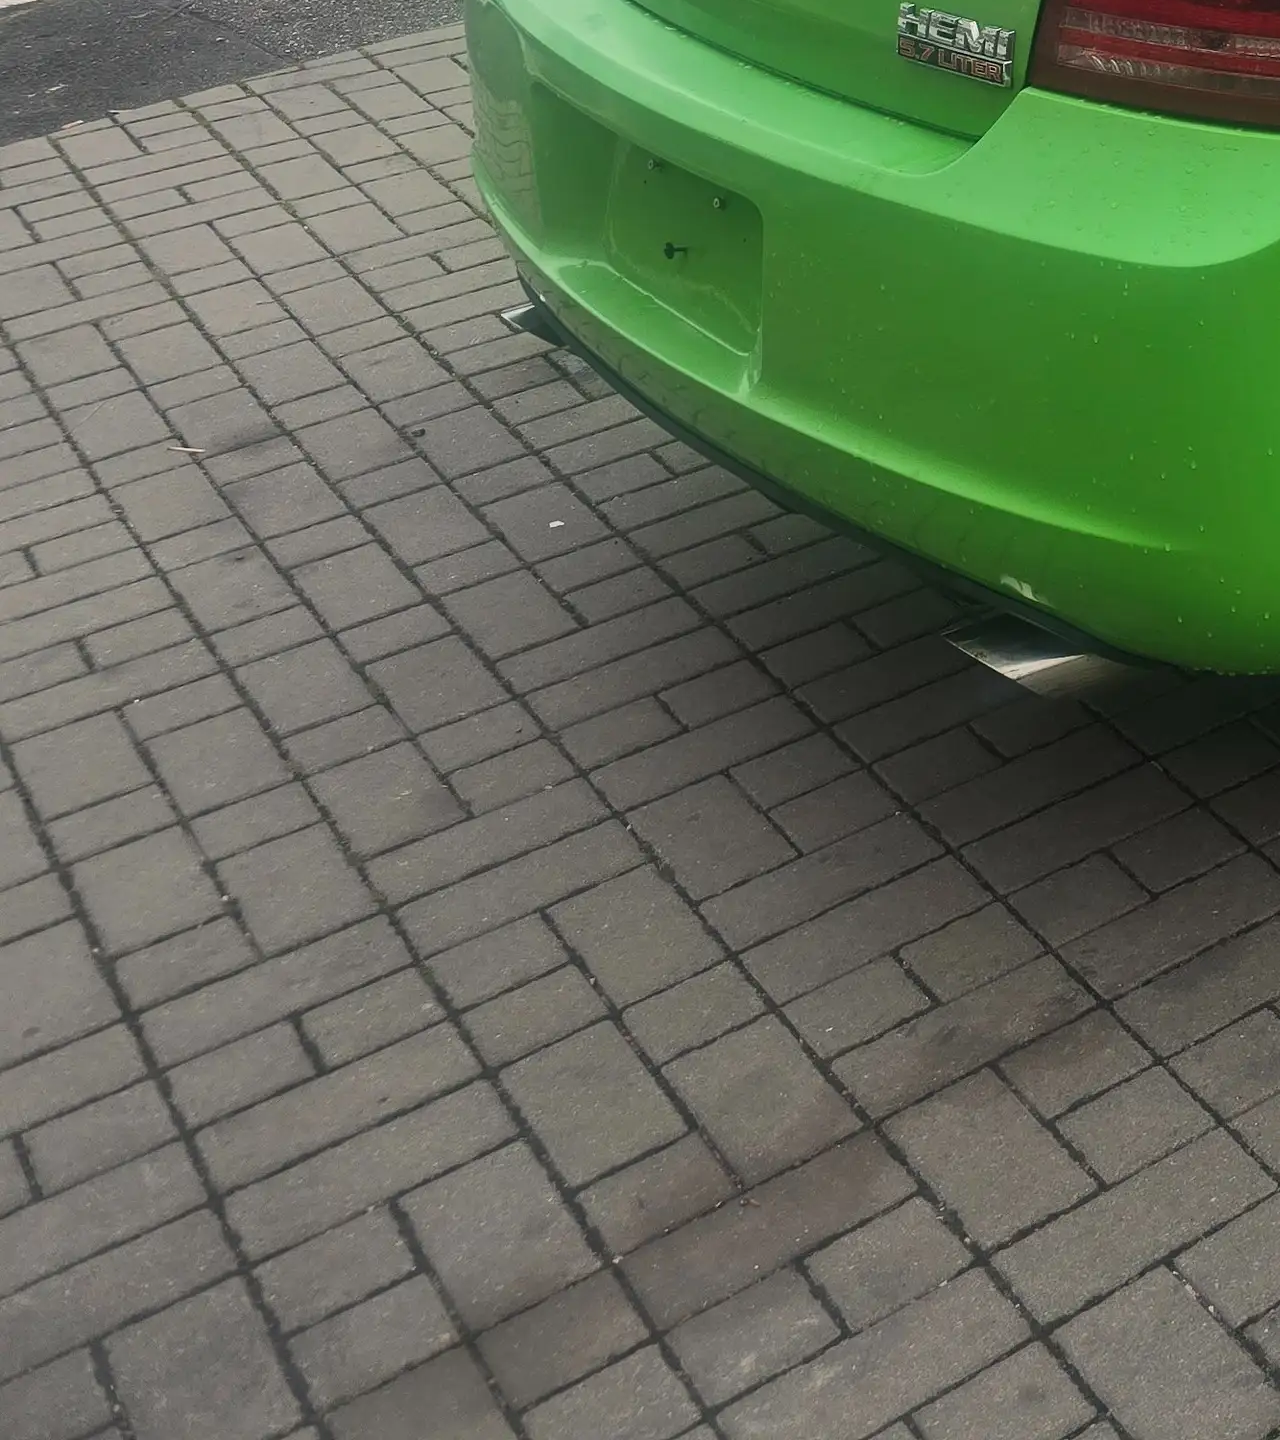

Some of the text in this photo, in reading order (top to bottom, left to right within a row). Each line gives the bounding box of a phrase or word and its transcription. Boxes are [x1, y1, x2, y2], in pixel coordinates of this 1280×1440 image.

[898, 1, 1015, 60] HEMI
[899, 37, 1001, 83] 5.7 LITER
